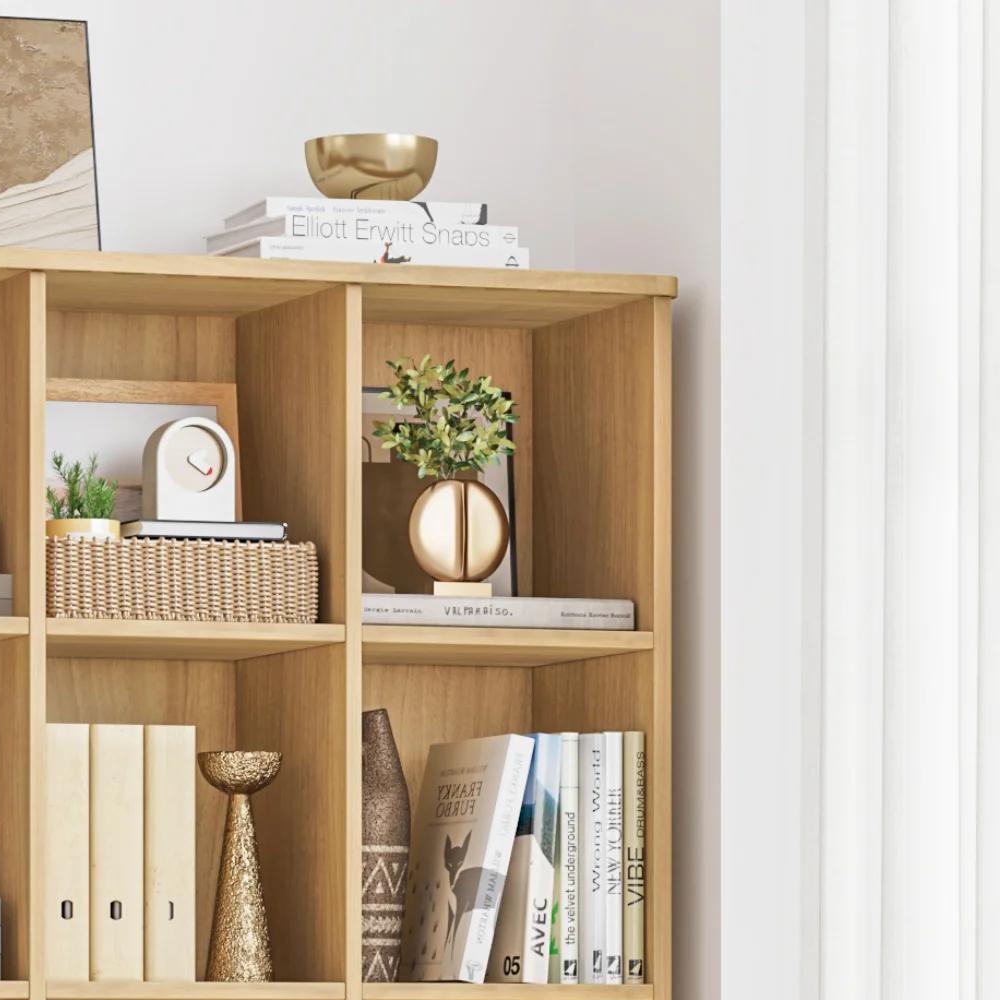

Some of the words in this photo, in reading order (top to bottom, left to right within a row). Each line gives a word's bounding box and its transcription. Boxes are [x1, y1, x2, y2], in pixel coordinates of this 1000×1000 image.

[292, 214, 347, 239] Elliott
[356, 218, 414, 242] Erwitt
[421, 221, 490, 247] Snaps
[591, 749, 602, 812] World
[565, 812, 577, 886] underground
[627, 846, 645, 907] VIBE
[636, 751, 645, 838] DRUM&BASS
[591, 821, 603, 893] Wrong
[607, 857, 622, 895] NEW
[529, 898, 548, 957] AVEC
[565, 889, 576, 923] velvet
[565, 926, 576, 945] the
[503, 956, 521, 976] 05
